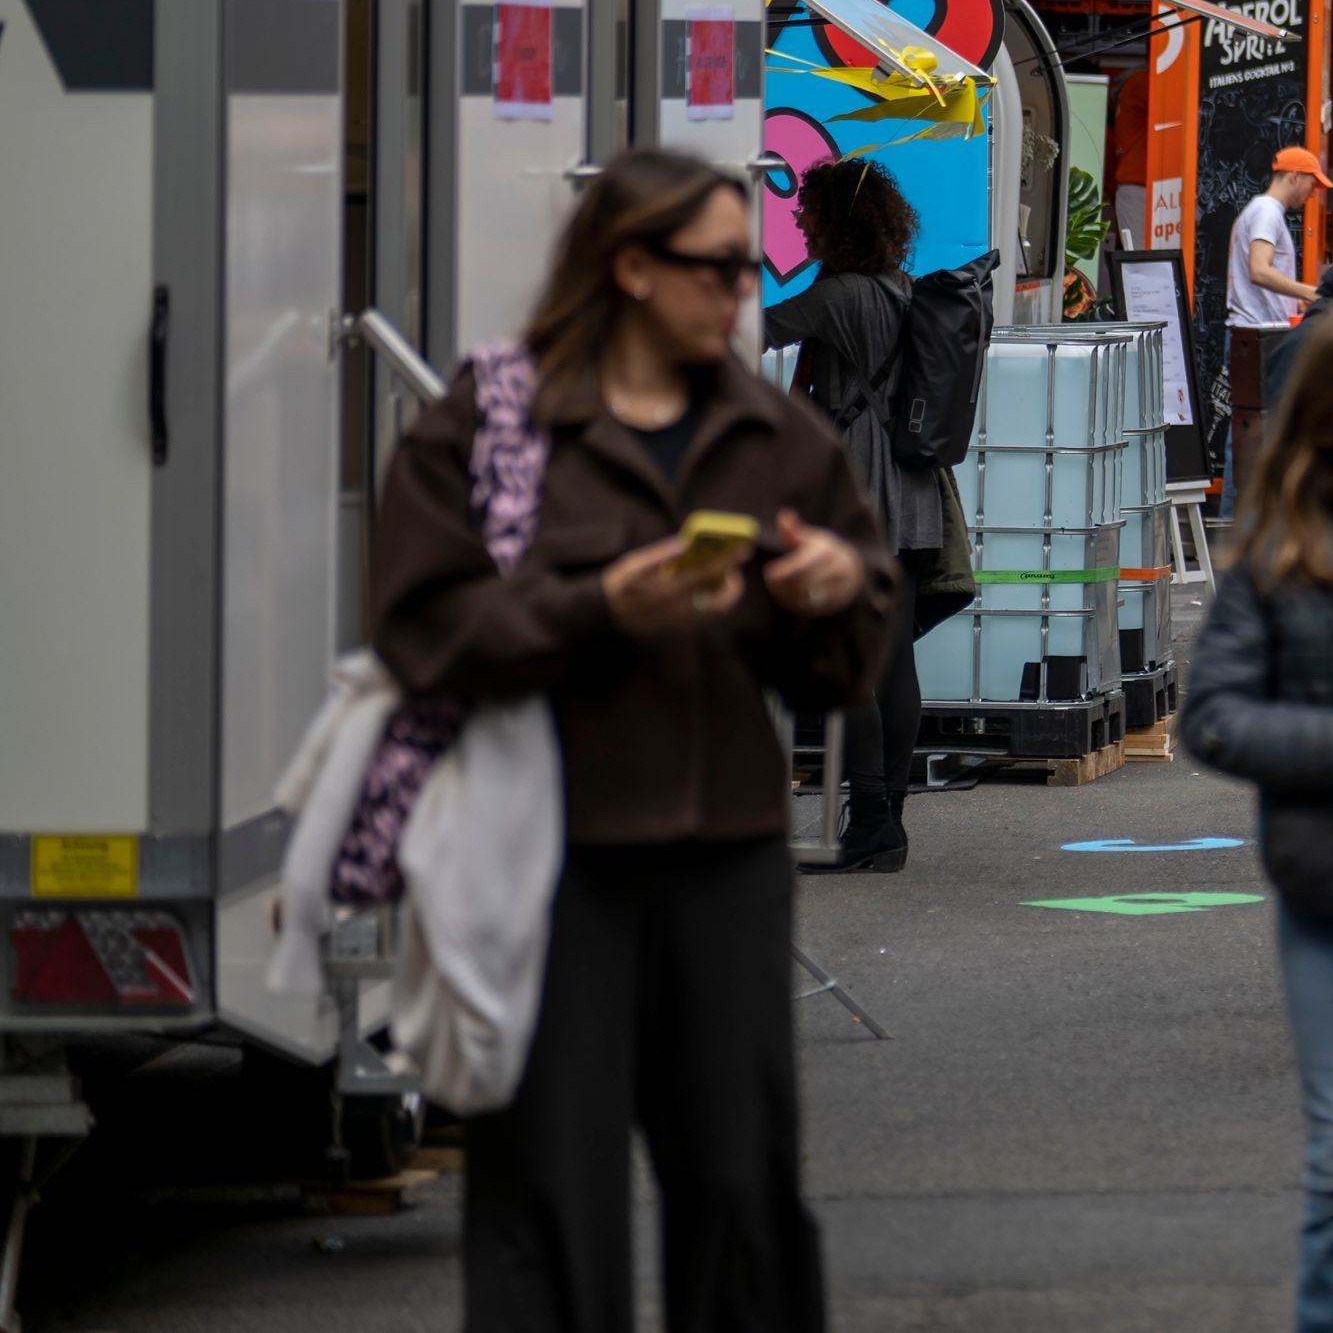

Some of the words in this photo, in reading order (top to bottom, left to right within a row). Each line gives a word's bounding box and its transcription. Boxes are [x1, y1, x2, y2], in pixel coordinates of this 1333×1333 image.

[1220, 32, 1286, 66] SPRI
[1209, 69, 1244, 89] ITALIENS
[1244, 64, 1280, 82] COCKTAIL
